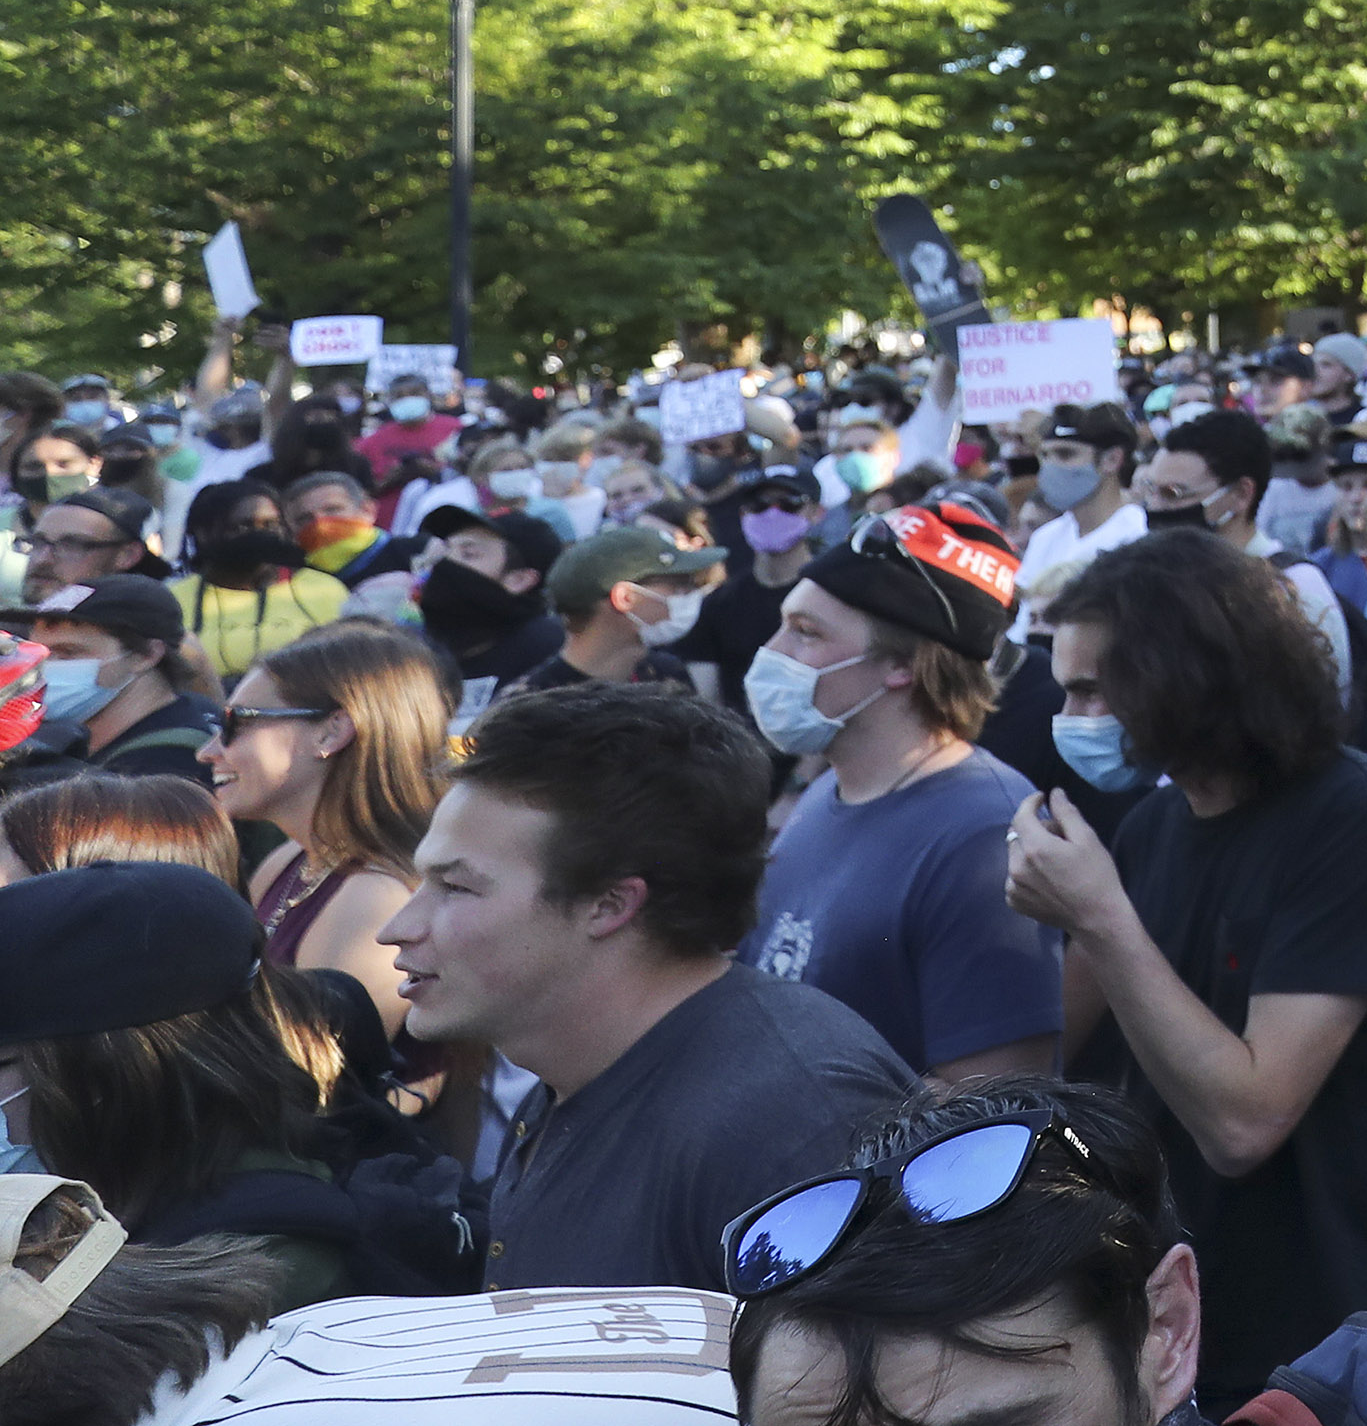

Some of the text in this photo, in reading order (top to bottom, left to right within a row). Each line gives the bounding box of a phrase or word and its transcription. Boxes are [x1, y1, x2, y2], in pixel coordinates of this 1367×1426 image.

[959, 324, 1051, 349] JUSTICE
[962, 358, 1005, 375] FOR
[965, 380, 1092, 409] BERNARDO
[588, 1303, 671, 1345] The
